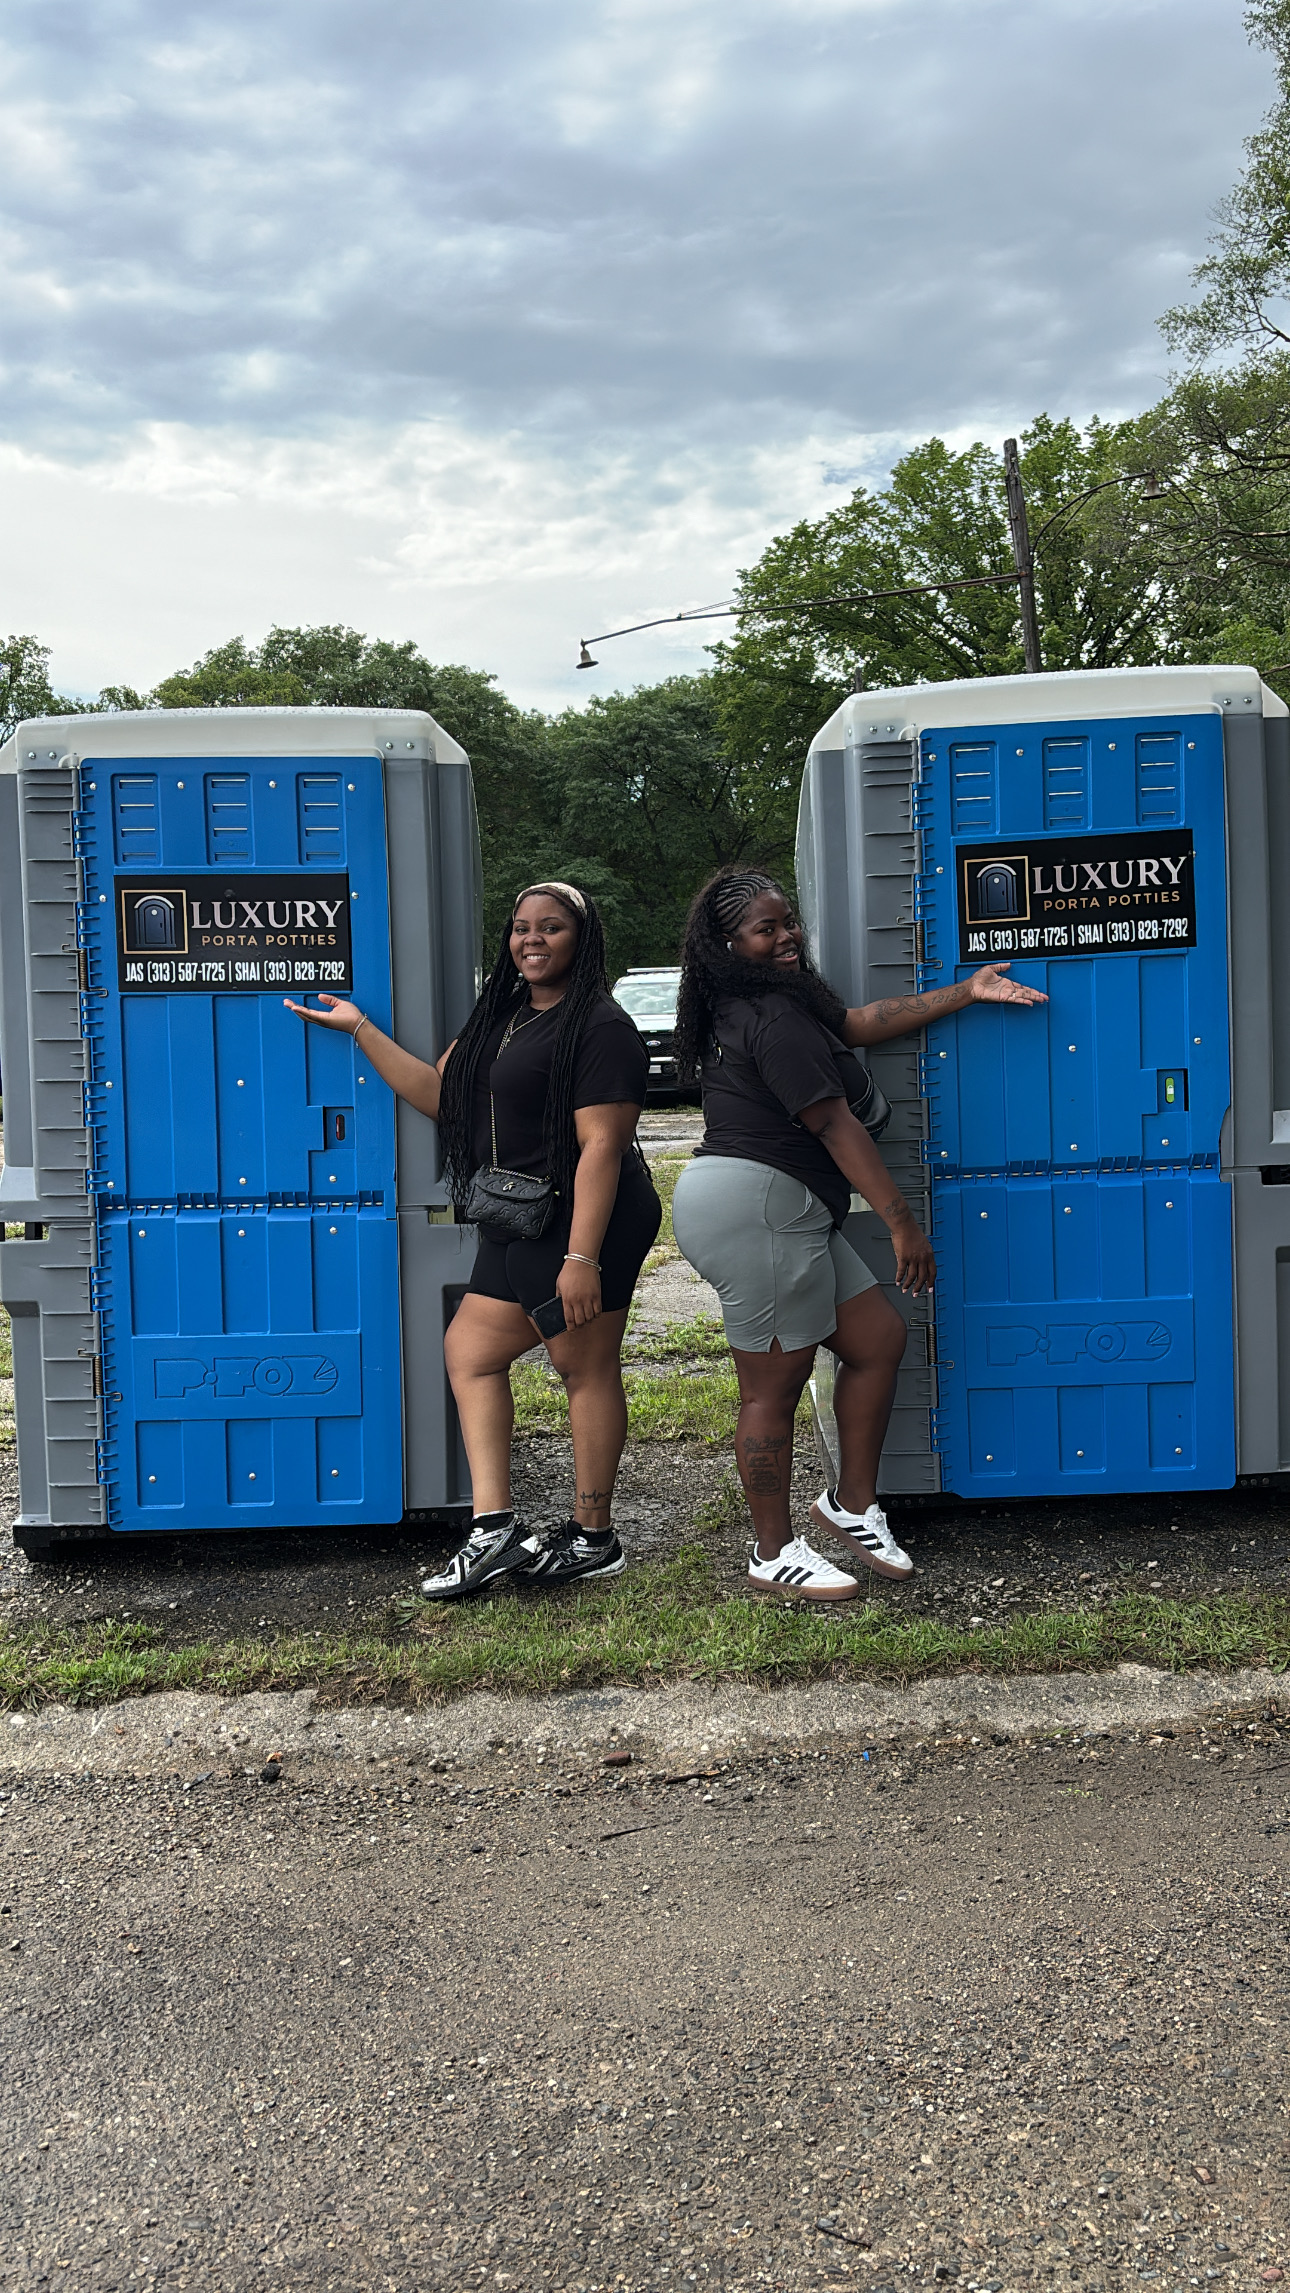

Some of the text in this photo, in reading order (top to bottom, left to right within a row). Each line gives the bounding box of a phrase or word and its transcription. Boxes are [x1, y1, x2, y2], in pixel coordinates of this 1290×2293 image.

[1032, 856, 1188, 894] LUXURY
[1044, 891, 1180, 911] PORTA POTTIES
[190, 900, 344, 929] LUXURY
[202, 934, 337, 946] PORTA POTTIES
[967, 932, 987, 952] JAS
[989, 928, 1018, 952] (313)
[1020, 926, 1068, 948] 587-1725
[1077, 923, 1103, 945] SHAI
[1106, 920, 1135, 944] (313)
[1137, 918, 1189, 940] 828-7292
[125, 962, 144, 982] JAS
[147, 961, 175, 983] (313)
[178, 962, 225, 982] 587-1725
[235, 961, 261, 982] SHAI
[263, 960, 292, 983] (313)
[294, 960, 345, 981] 828-7292
